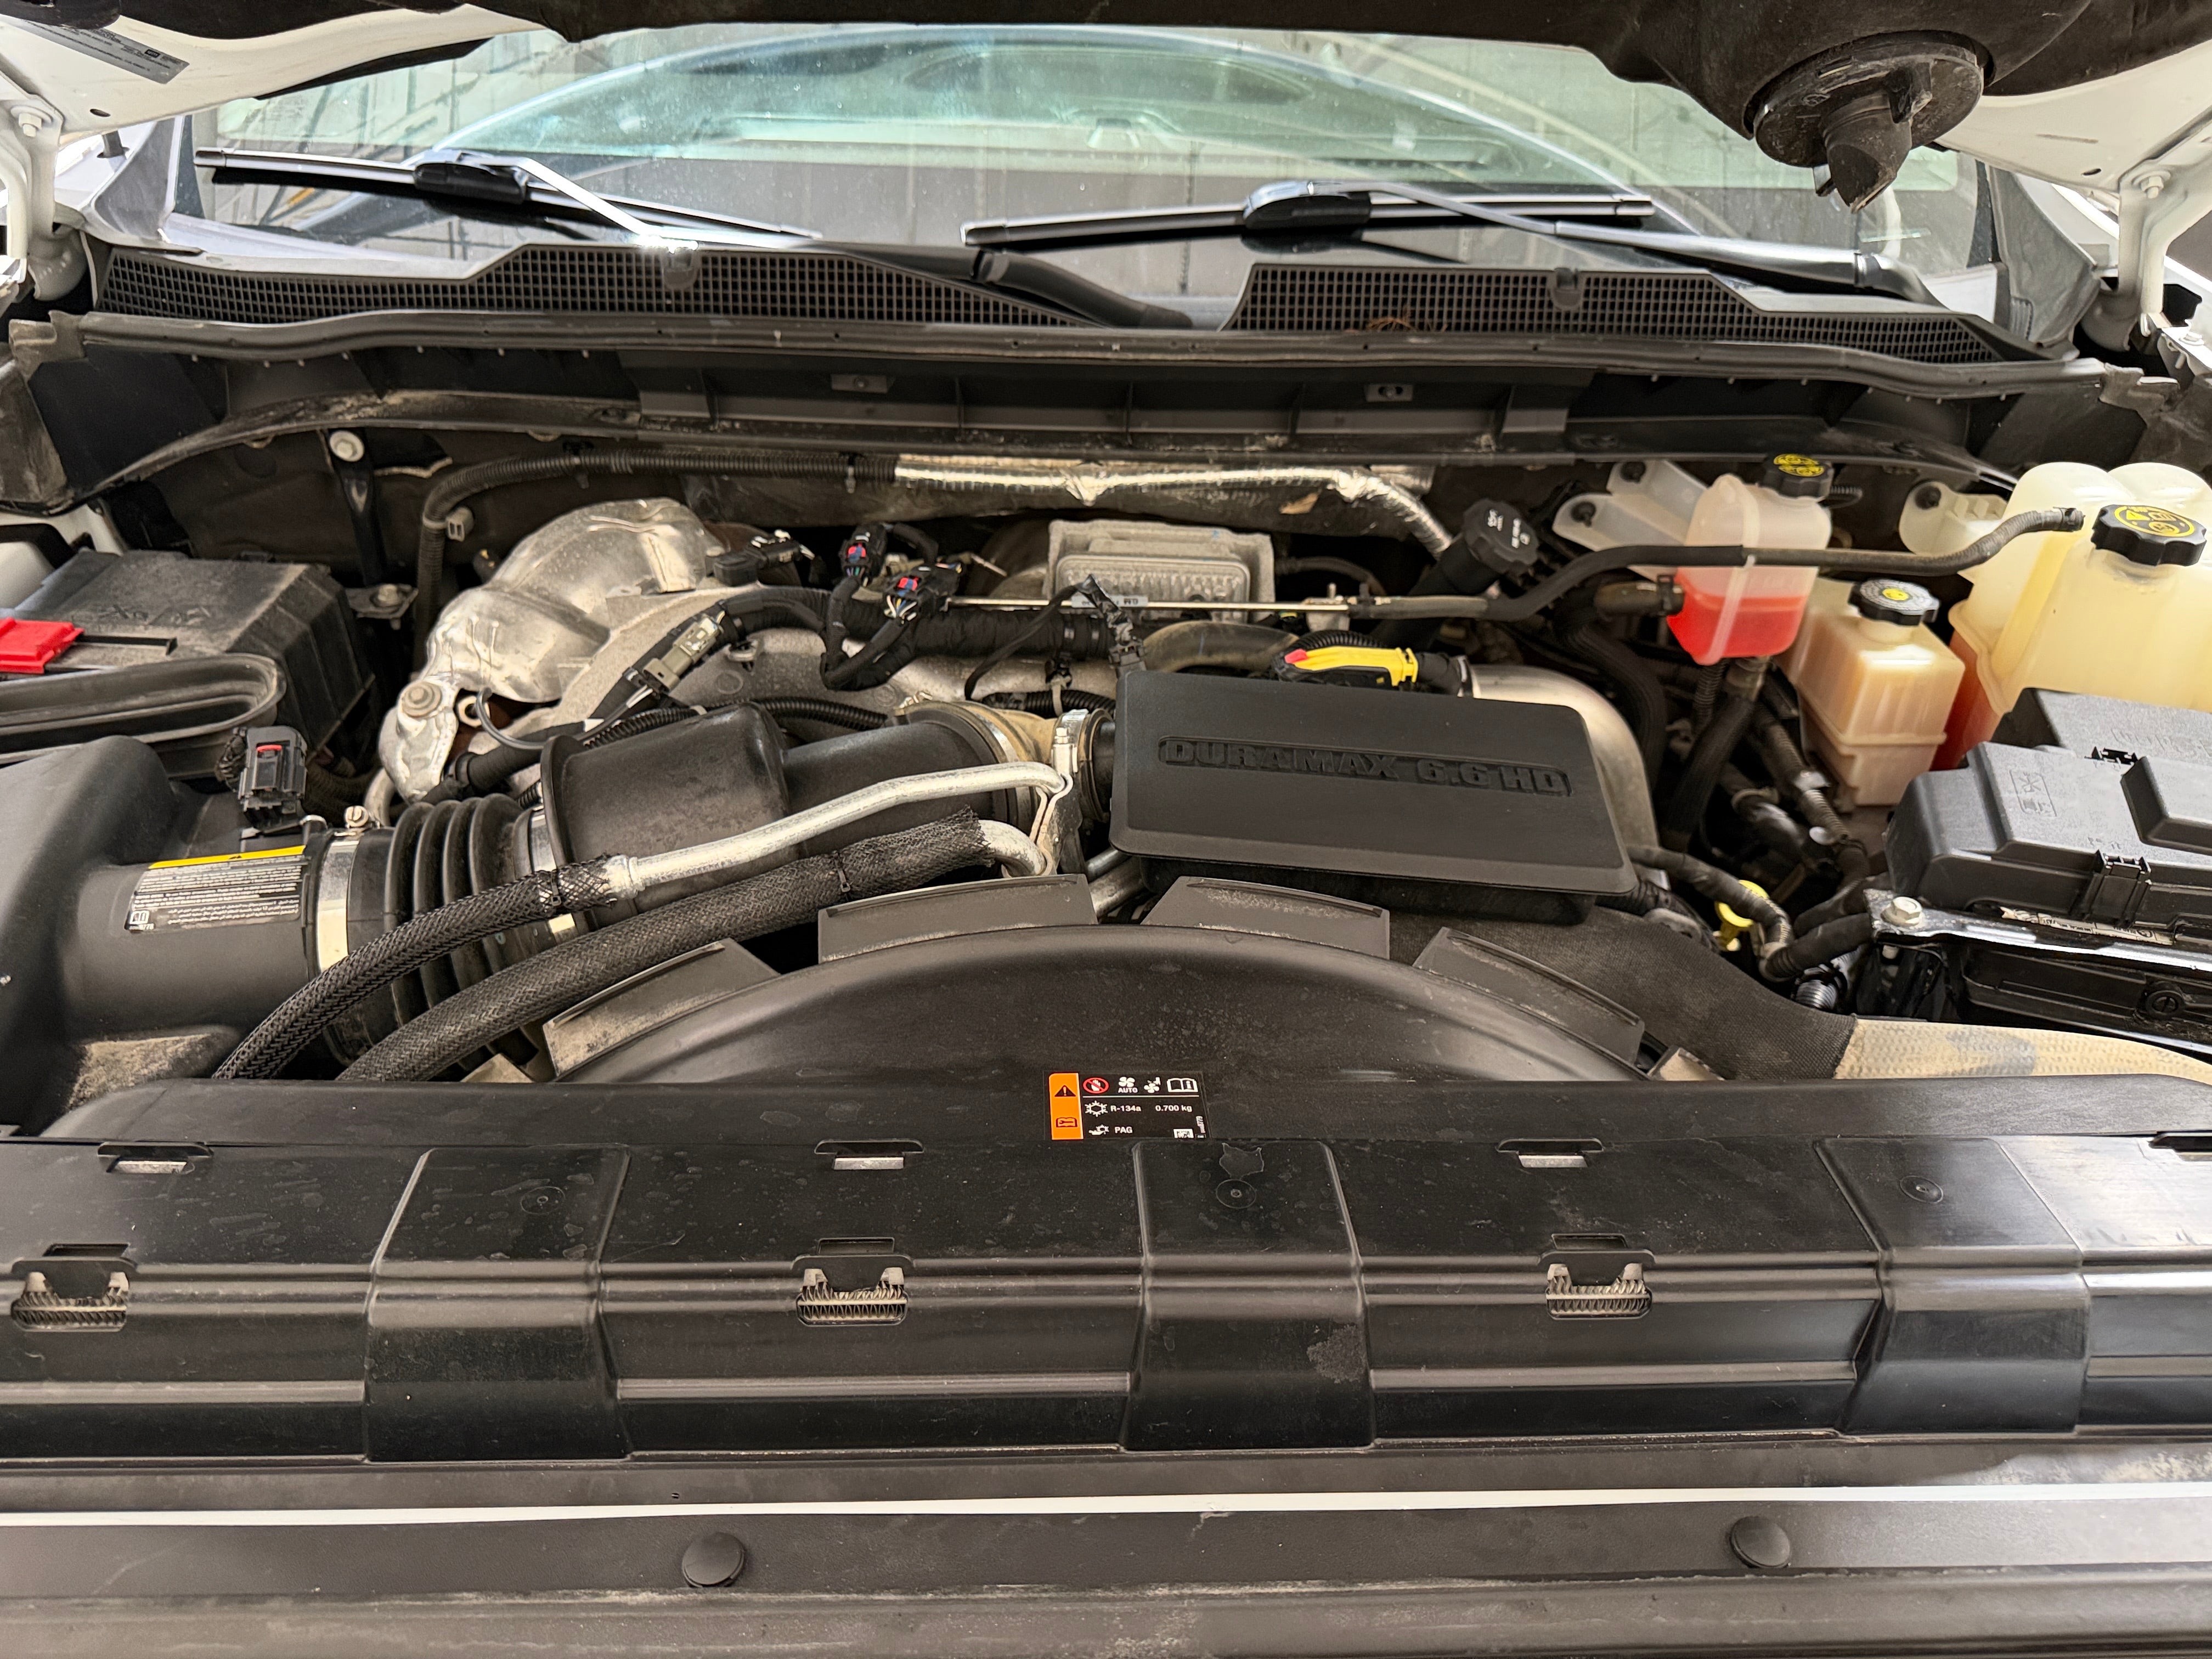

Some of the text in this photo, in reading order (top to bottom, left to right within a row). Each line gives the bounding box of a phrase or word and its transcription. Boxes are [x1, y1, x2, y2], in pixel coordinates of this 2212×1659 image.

[1165, 741, 1566, 794] DURAMAX 6.6 HD
[1181, 1104, 1193, 1113] kg
